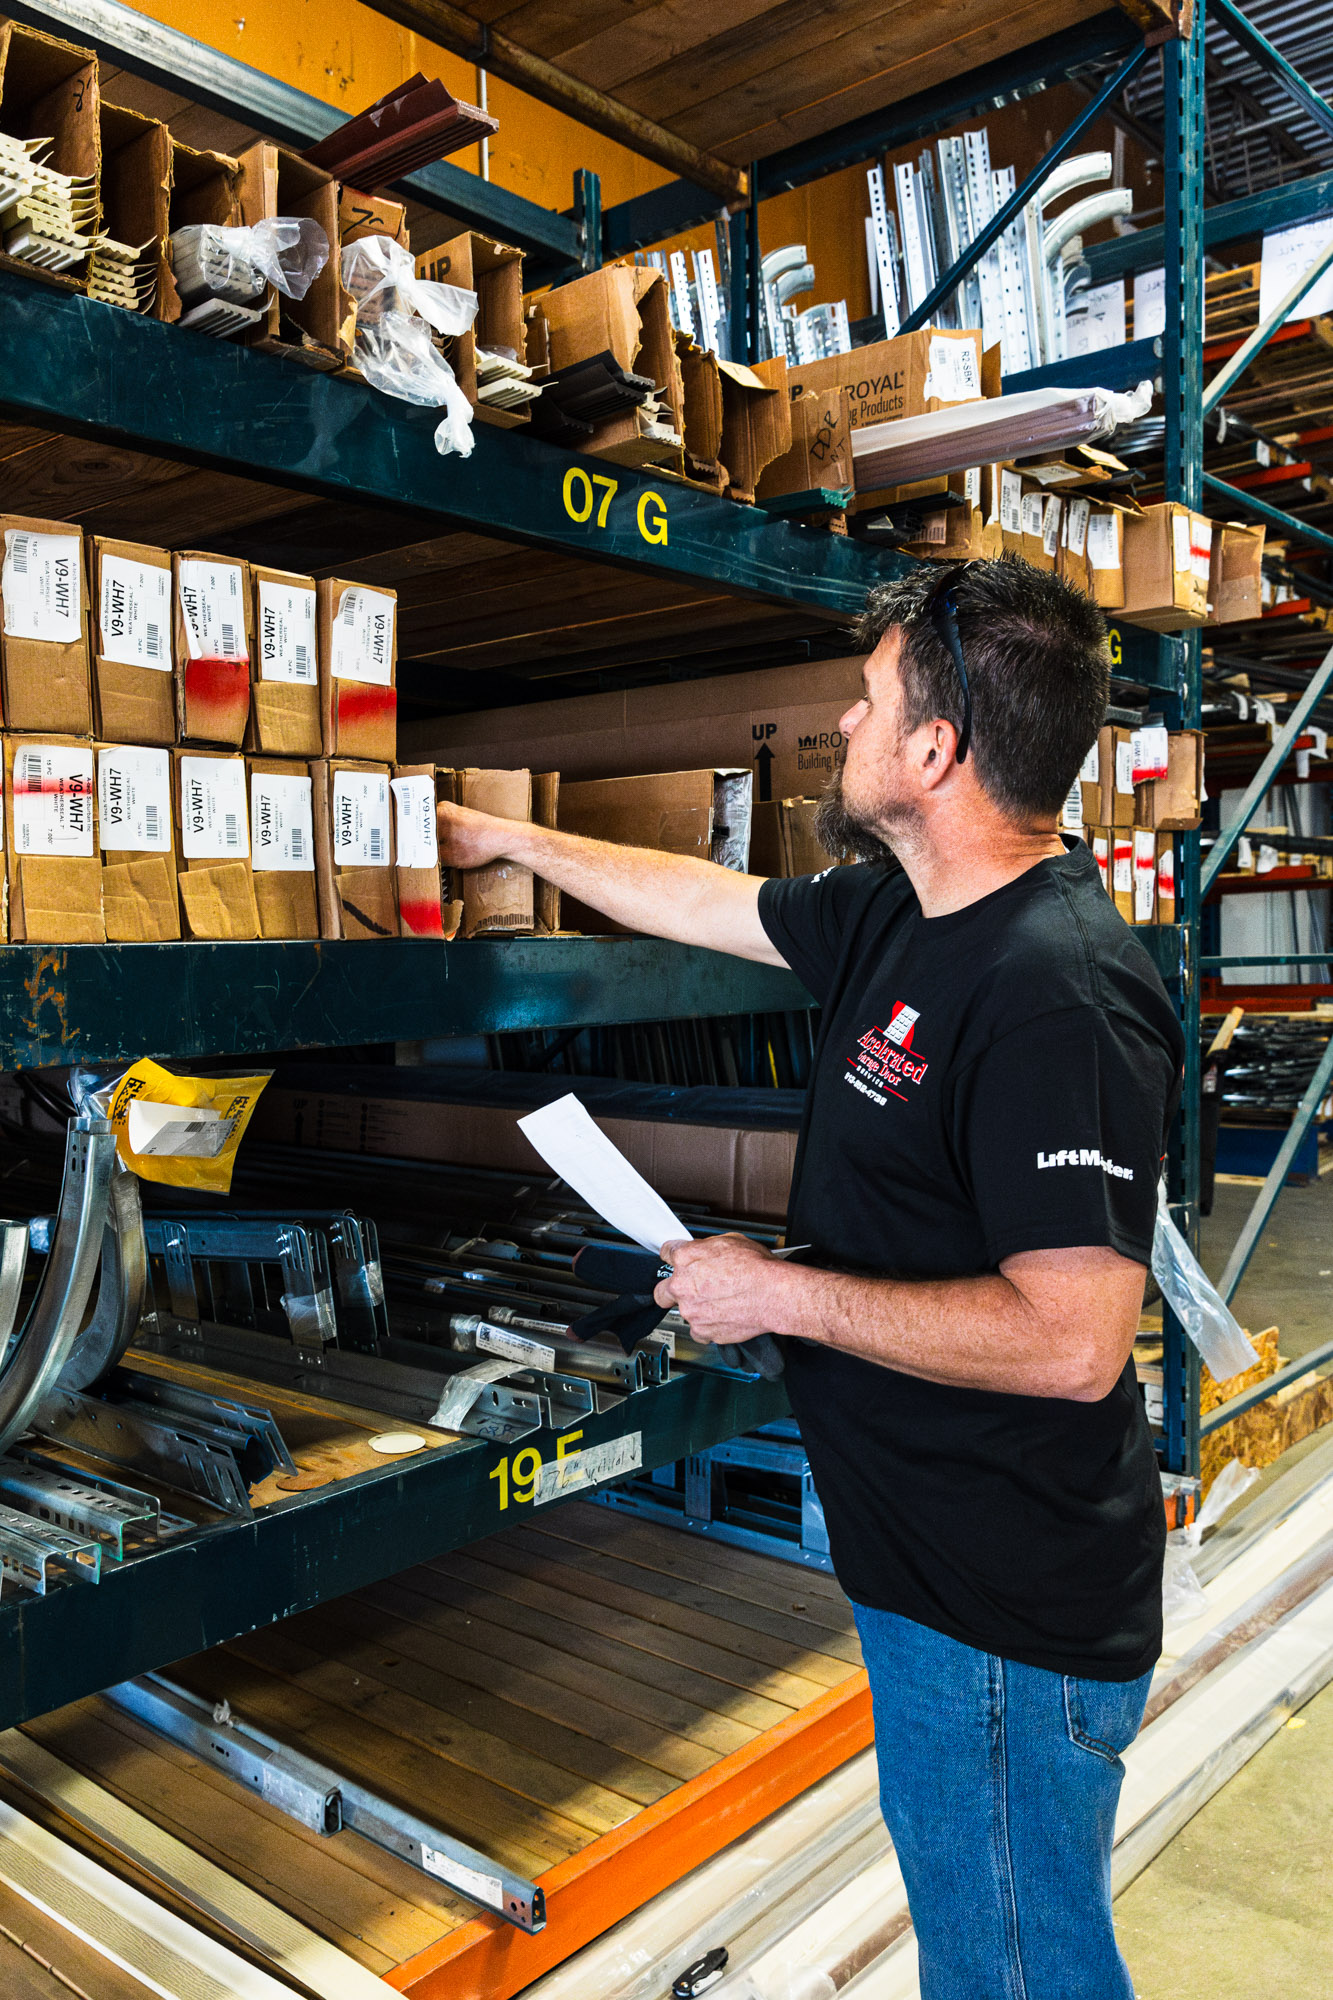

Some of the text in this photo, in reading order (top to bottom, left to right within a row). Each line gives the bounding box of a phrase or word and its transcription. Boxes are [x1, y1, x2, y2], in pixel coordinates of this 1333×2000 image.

[860, 395, 904, 419] Products
[562, 466, 669, 547] 07 G
[55, 558, 70, 618] V9-WH7
[111, 579, 125, 637] V9-WH7
[264, 606, 276, 660] V9-WH7
[372, 614, 386, 664] V9-WH7
[1108, 628, 1122, 664] G
[752, 723, 778, 741] UP
[46, 767, 53, 775] PC
[798, 750, 832, 773] Building
[69, 773, 84, 833] V9-WH7
[109, 767, 123, 824] V9-WH7
[191, 779, 205, 834] V9-WH7
[260, 794, 272, 847] V9-WH7
[341, 795, 352, 847] V9-WH7
[422, 796, 432, 846] V9-WH7
[878, 1063, 902, 1086] Door
[1036, 1148, 1134, 1181] LiftMter
[489, 1447, 543, 1511] 19
